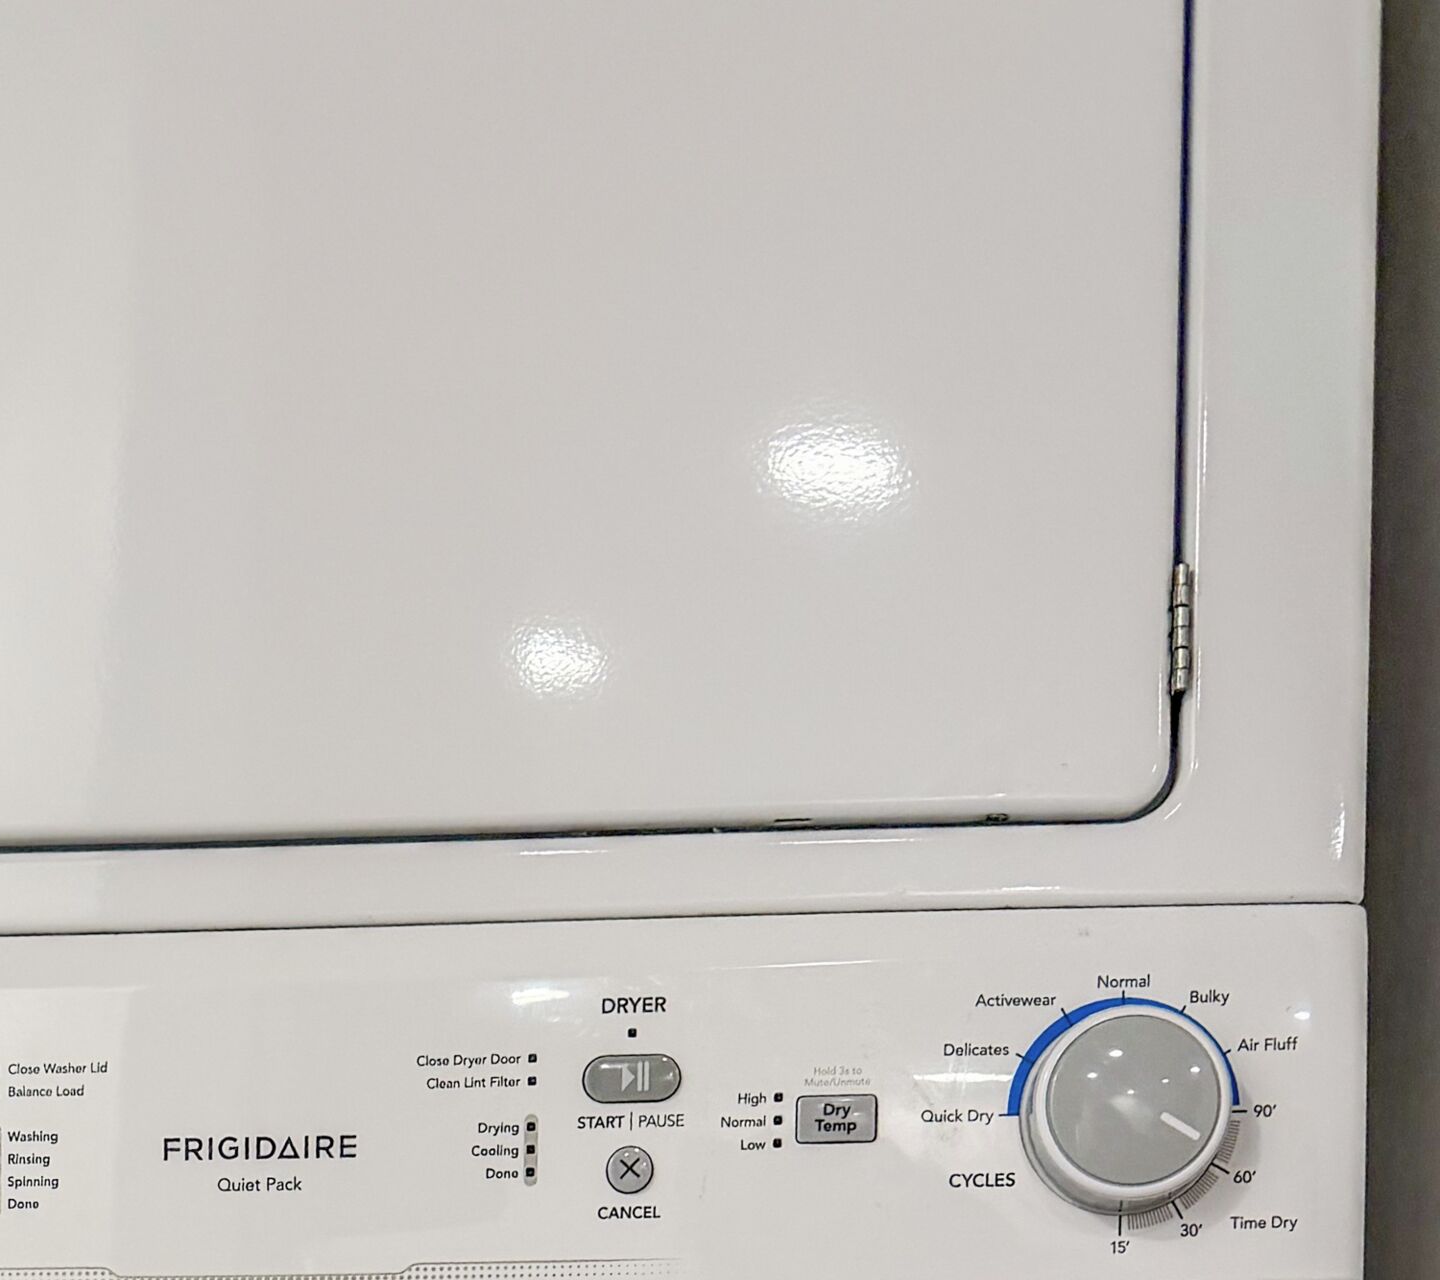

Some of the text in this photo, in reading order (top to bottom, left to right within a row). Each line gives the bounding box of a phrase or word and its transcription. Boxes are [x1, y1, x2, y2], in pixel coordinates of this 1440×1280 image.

[1097, 974, 1150, 988] Normal
[975, 994, 1056, 1007] Activewear
[1190, 989, 1229, 1005] Bulky
[602, 997, 666, 1014] DRYER
[944, 1043, 1009, 1056] Delicates
[1237, 1036, 1298, 1051] Air Fluff
[8, 1061, 108, 1075] Close Washer Lid
[417, 1054, 521, 1068] Close Dryer Door
[427, 1076, 520, 1089] Clean Lint Filter
[9, 1085, 84, 1097] Balance Load
[738, 1093, 766, 1106] High
[577, 1114, 684, 1129] START PAUSE
[721, 1115, 766, 1127] Normal
[814, 1103, 857, 1134] Dry Temp
[921, 1109, 993, 1125] Quick Dry
[478, 1122, 519, 1136] Drying
[8, 1131, 58, 1144] Washing
[164, 1135, 356, 1161] FRIGIDAIRE
[472, 1144, 518, 1158] Cooling
[741, 1140, 766, 1150] Low
[8, 1153, 50, 1167] Rinsing
[486, 1168, 518, 1179] Done
[949, 1172, 1015, 1188] CYCLES
[8, 1176, 58, 1189] Spinning
[218, 1176, 301, 1191] Quiet Pack
[8, 1199, 39, 1209] Done
[598, 1206, 660, 1219] CANCEL
[1230, 1216, 1297, 1232] Time Dry
